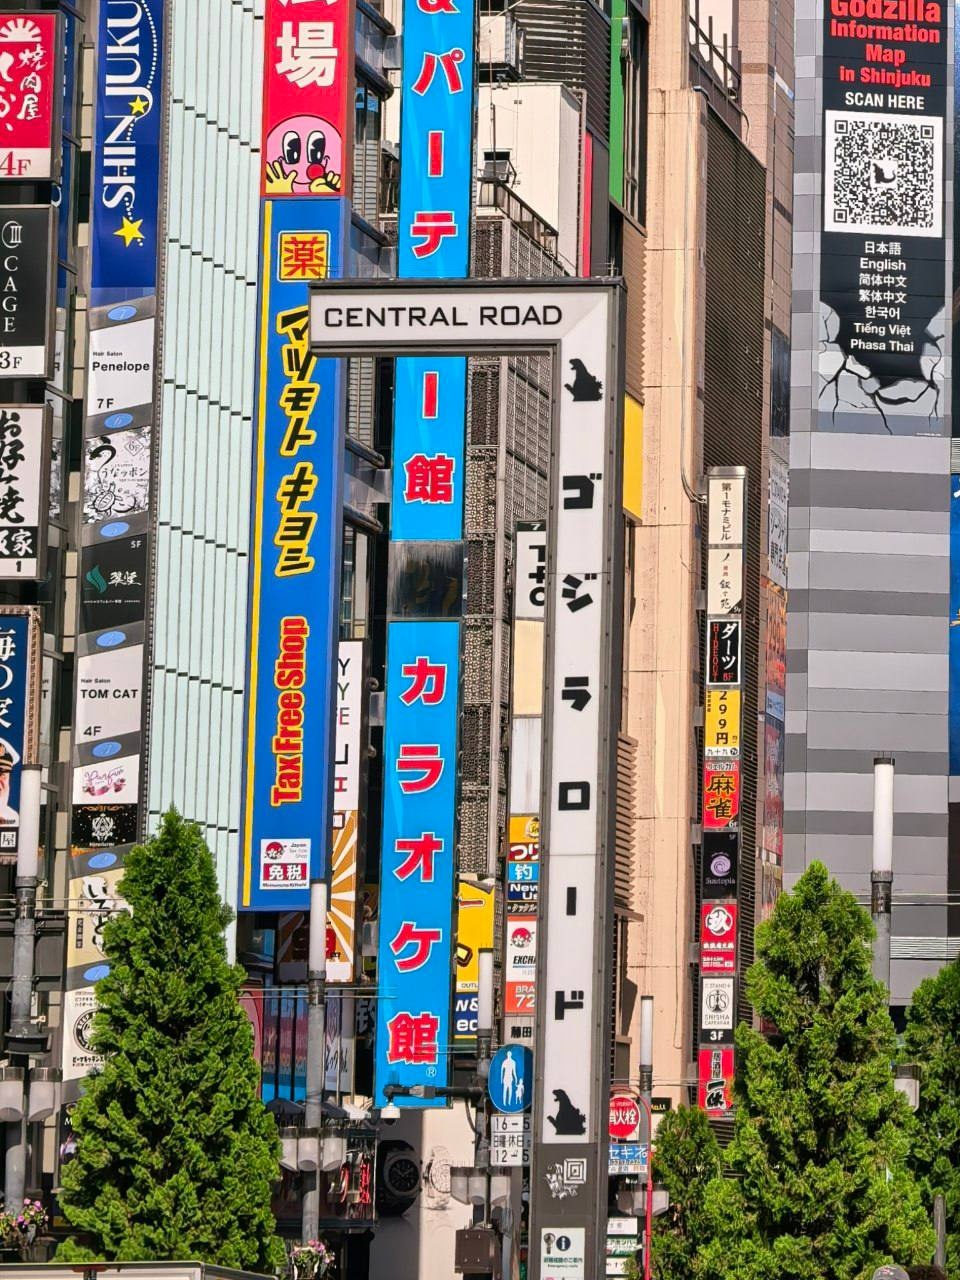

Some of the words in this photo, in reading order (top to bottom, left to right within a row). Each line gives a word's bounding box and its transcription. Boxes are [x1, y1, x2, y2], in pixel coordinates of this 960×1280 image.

[830, 18, 941, 44] Information
[865, 43, 906, 67] Map
[16, 43, 48, 120] 焼肉屋
[839, 66, 855, 82] in
[860, 67, 931, 88] Shinjuku
[102, 0, 154, 209] SHINJUKU
[845, 91, 884, 108] SCAN
[888, 95, 925, 110] HERE
[0, 150, 31, 176] 4F
[283, 235, 325, 278] 薬
[864, 241, 902, 255] 日本語
[859, 257, 907, 272] English
[859, 273, 907, 287] 简体中文
[2, 255, 19, 333] CAGE
[324, 305, 468, 328] CENTRAL
[479, 304, 563, 326] ROAD
[865, 306, 901, 320] 한국어
[853, 322, 886, 336] Tiếng
[889, 323, 912, 338] Việt
[850, 338, 887, 351] Phasa
[889, 340, 914, 352] Thai
[0, 351, 22, 369] 3F
[92, 361, 150, 373] Penelope
[97, 398, 115, 409] 7F
[276, 616, 309, 688] Shop
[721, 622, 738, 670] ダーツ
[80, 689, 109, 699] TOM
[112, 689, 138, 699] CAT
[83, 726, 102, 737] 4F
[274, 692, 304, 755] Free
[272, 756, 303, 806] Tax
[706, 773, 735, 819] 麻雀
[385, 656, 448, 1066] カラオケ館
[269, 864, 302, 880] 免税
[515, 863, 533, 880] 釣
[710, 1031, 724, 1041] 3F
